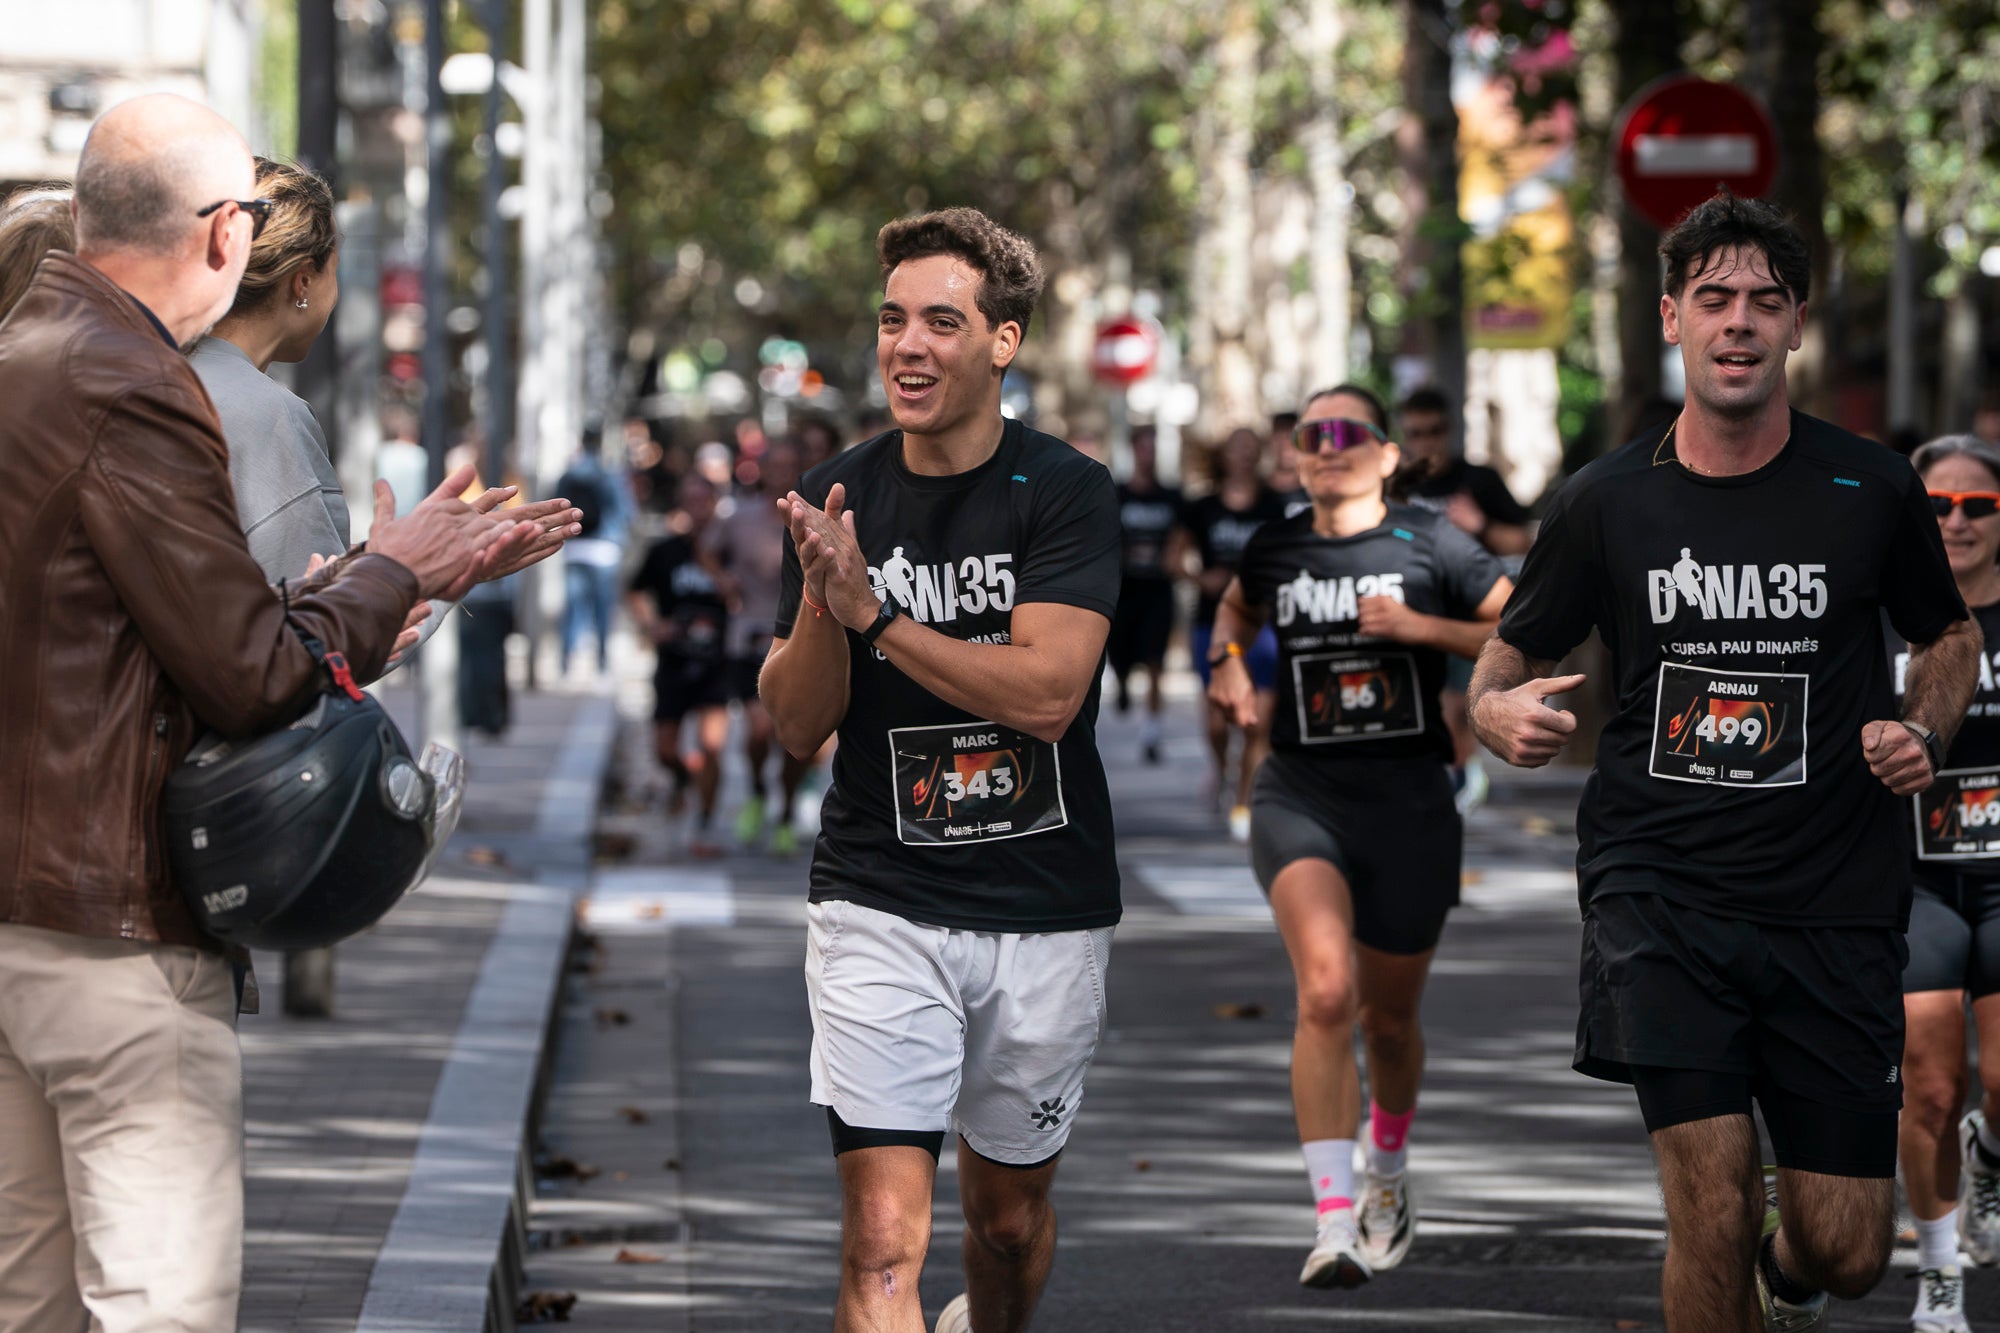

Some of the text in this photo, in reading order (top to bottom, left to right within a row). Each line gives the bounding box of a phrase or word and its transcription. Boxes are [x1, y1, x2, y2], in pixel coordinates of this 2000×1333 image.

[1671, 642, 1717, 655] CURSA
[1721, 641, 1751, 654] PAU
[1756, 636, 1819, 655] DINARÈS
[1707, 681, 1758, 696] ARNAU
[1695, 714, 1762, 746] 499
[952, 733, 999, 749] MARC
[943, 766, 1014, 802] 343
